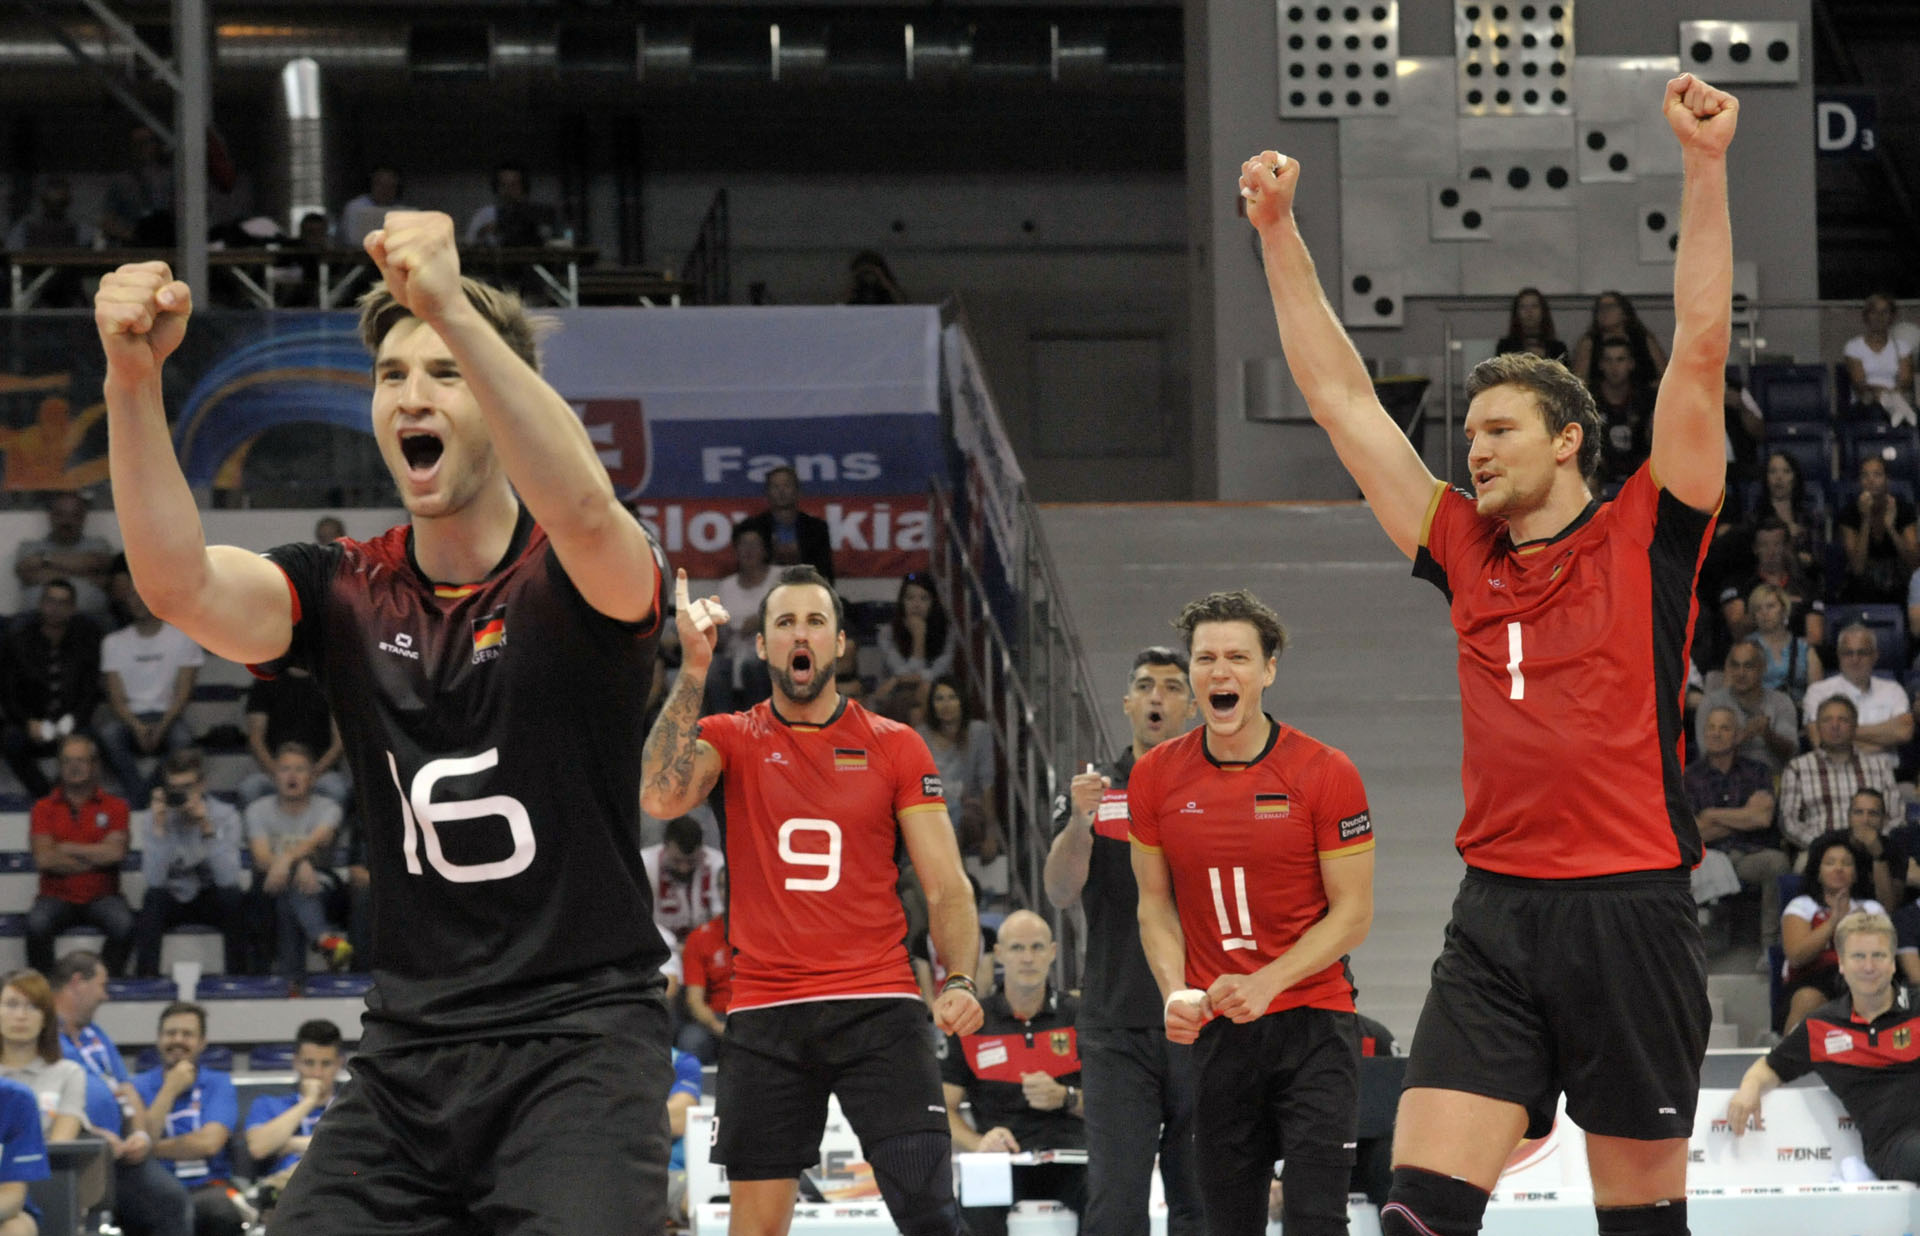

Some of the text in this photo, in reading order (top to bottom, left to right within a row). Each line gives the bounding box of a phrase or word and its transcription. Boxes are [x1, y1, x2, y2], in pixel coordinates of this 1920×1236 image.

[703, 447, 882, 483] Fans
[637, 503, 932, 552] lokia
[1506, 621, 1525, 700] 1
[386, 747, 537, 883] 16
[778, 818, 842, 892] 9
